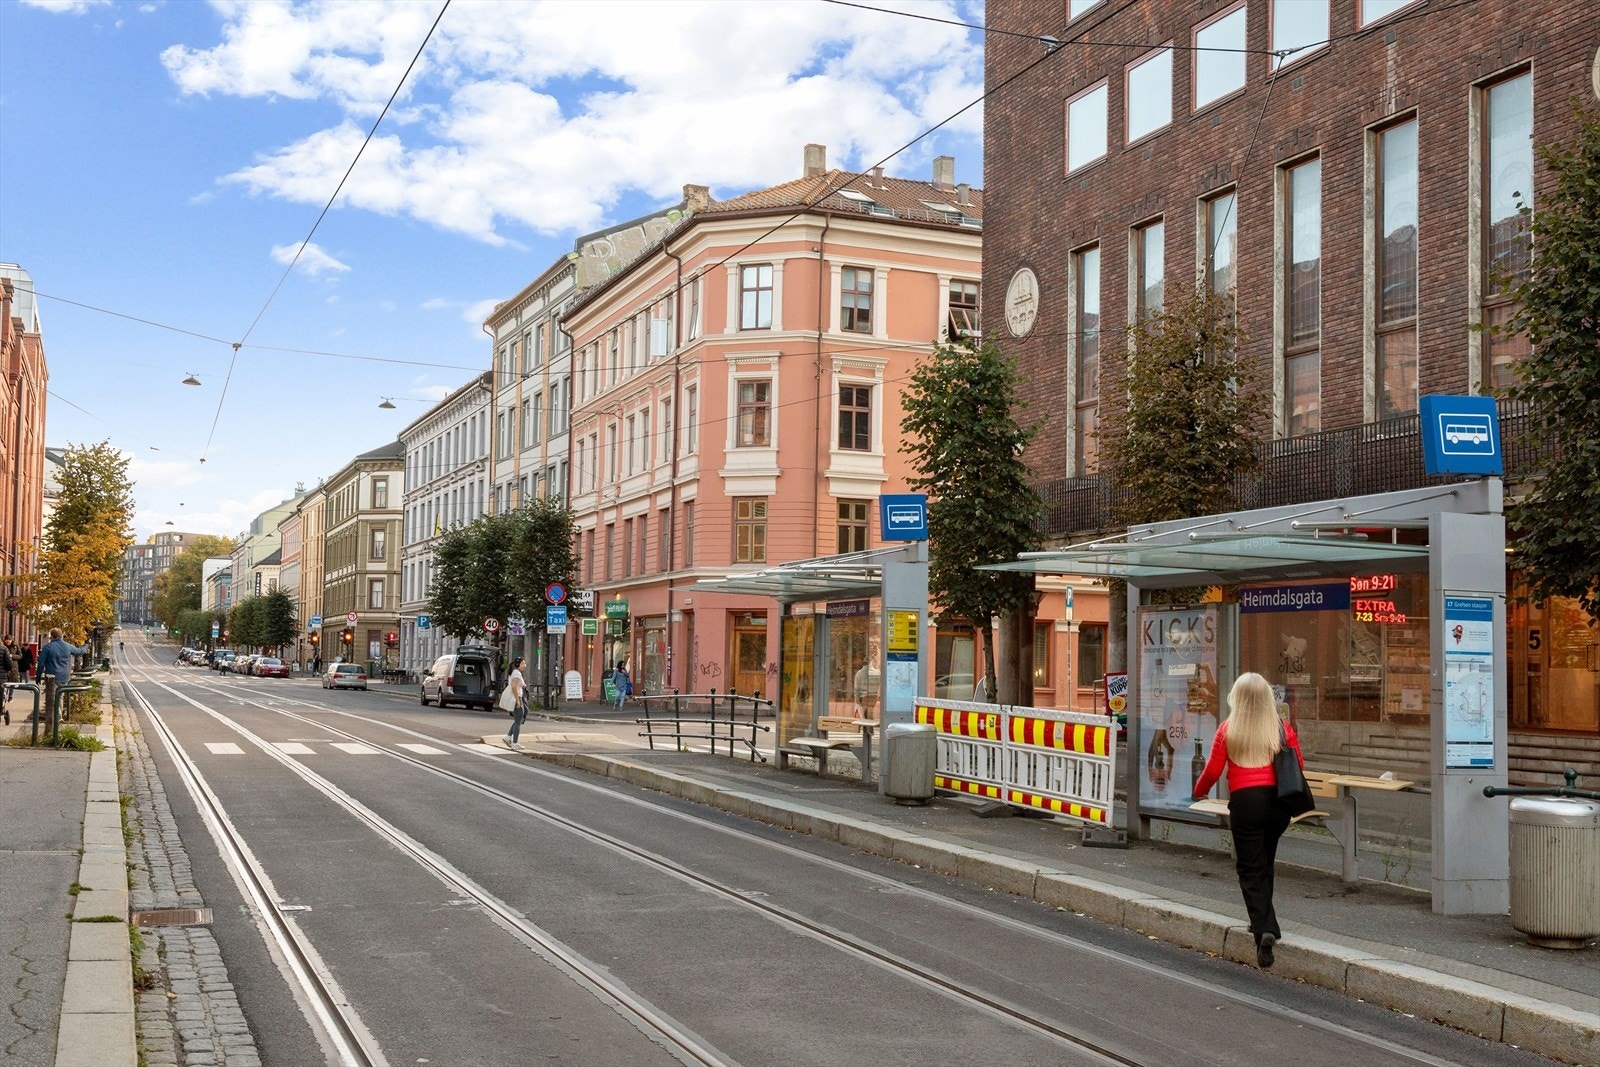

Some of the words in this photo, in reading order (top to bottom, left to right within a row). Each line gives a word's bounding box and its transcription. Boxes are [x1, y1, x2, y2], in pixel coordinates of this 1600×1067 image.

[1372, 575, 1394, 590] 9-21
[1243, 588, 1323, 609] Heimdalsgata
[1356, 600, 1395, 612] EXTRA
[420, 616, 427, 626] P
[1356, 612, 1373, 622] 7-23
[486, 620, 498, 629] 40
[1143, 616, 1214, 645] KICKS
[1529, 630, 1541, 650] 5
[1170, 726, 1187, 738] 25%
